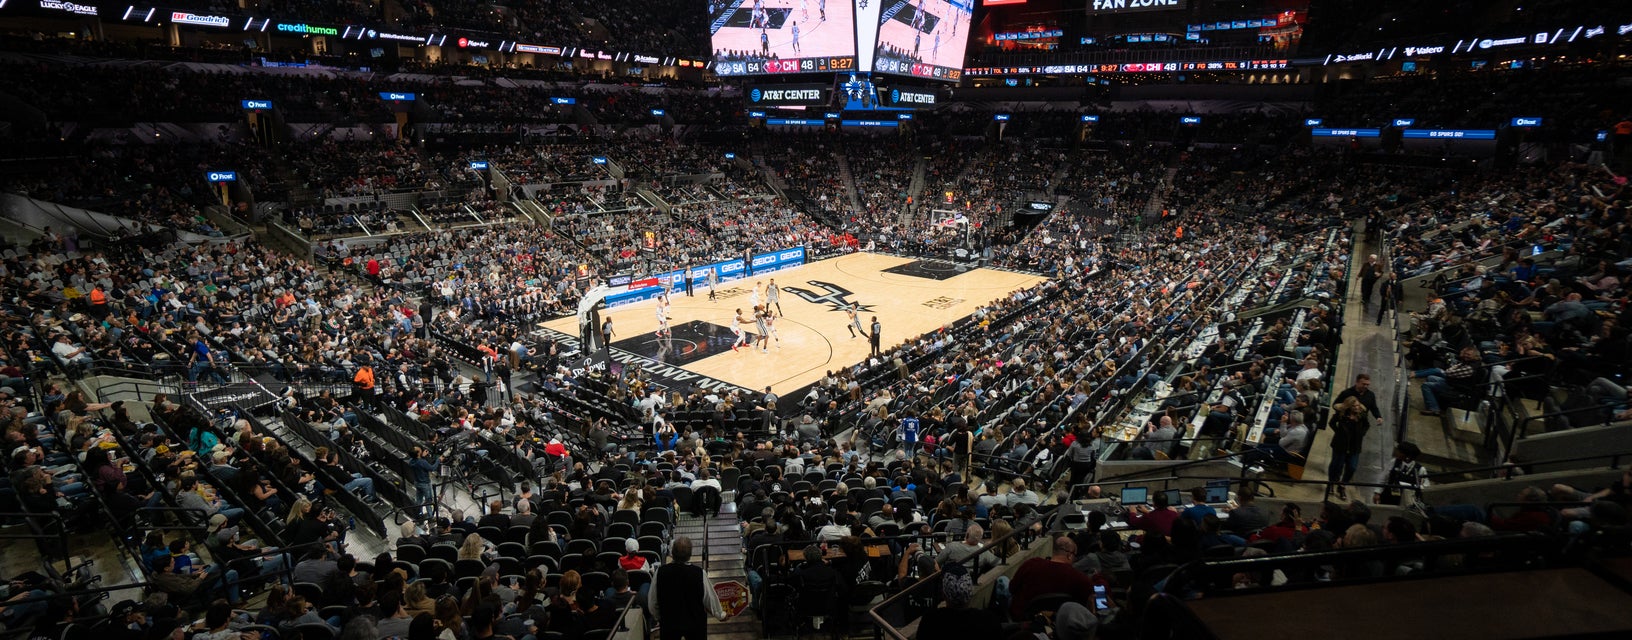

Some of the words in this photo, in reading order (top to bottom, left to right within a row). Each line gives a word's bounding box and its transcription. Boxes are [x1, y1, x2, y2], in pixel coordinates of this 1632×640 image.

[40, 1, 64, 10] LUCKY
[1093, 0, 1125, 10] FAN
[173, 13, 229, 24] BFGoodrich
[277, 23, 338, 35] credithuman
[1416, 46, 1444, 55] Valero
[1346, 52, 1373, 62] SeaWorld
[732, 63, 744, 73] SA
[748, 63, 759, 72] 64
[782, 59, 797, 71] CHI
[801, 60, 814, 70] 48
[830, 58, 853, 69] 9:27
[890, 61, 898, 71] SA
[900, 62, 908, 72] 64
[923, 65, 934, 76] CHI
[933, 67, 941, 77] 48
[948, 70, 960, 79] 9:27
[1064, 65, 1075, 73] SA
[1077, 65, 1088, 73] 64
[1100, 64, 1118, 72] 9:27
[1163, 63, 1176, 71] 48
[762, 90, 783, 100] AT&T
[784, 89, 820, 100] CENTER
[900, 91, 914, 102] AT&T
[914, 93, 935, 104] CENTER
[752, 255, 776, 266] GEICO
[780, 250, 802, 260] GEICO
[609, 348, 699, 381] ANTONI
